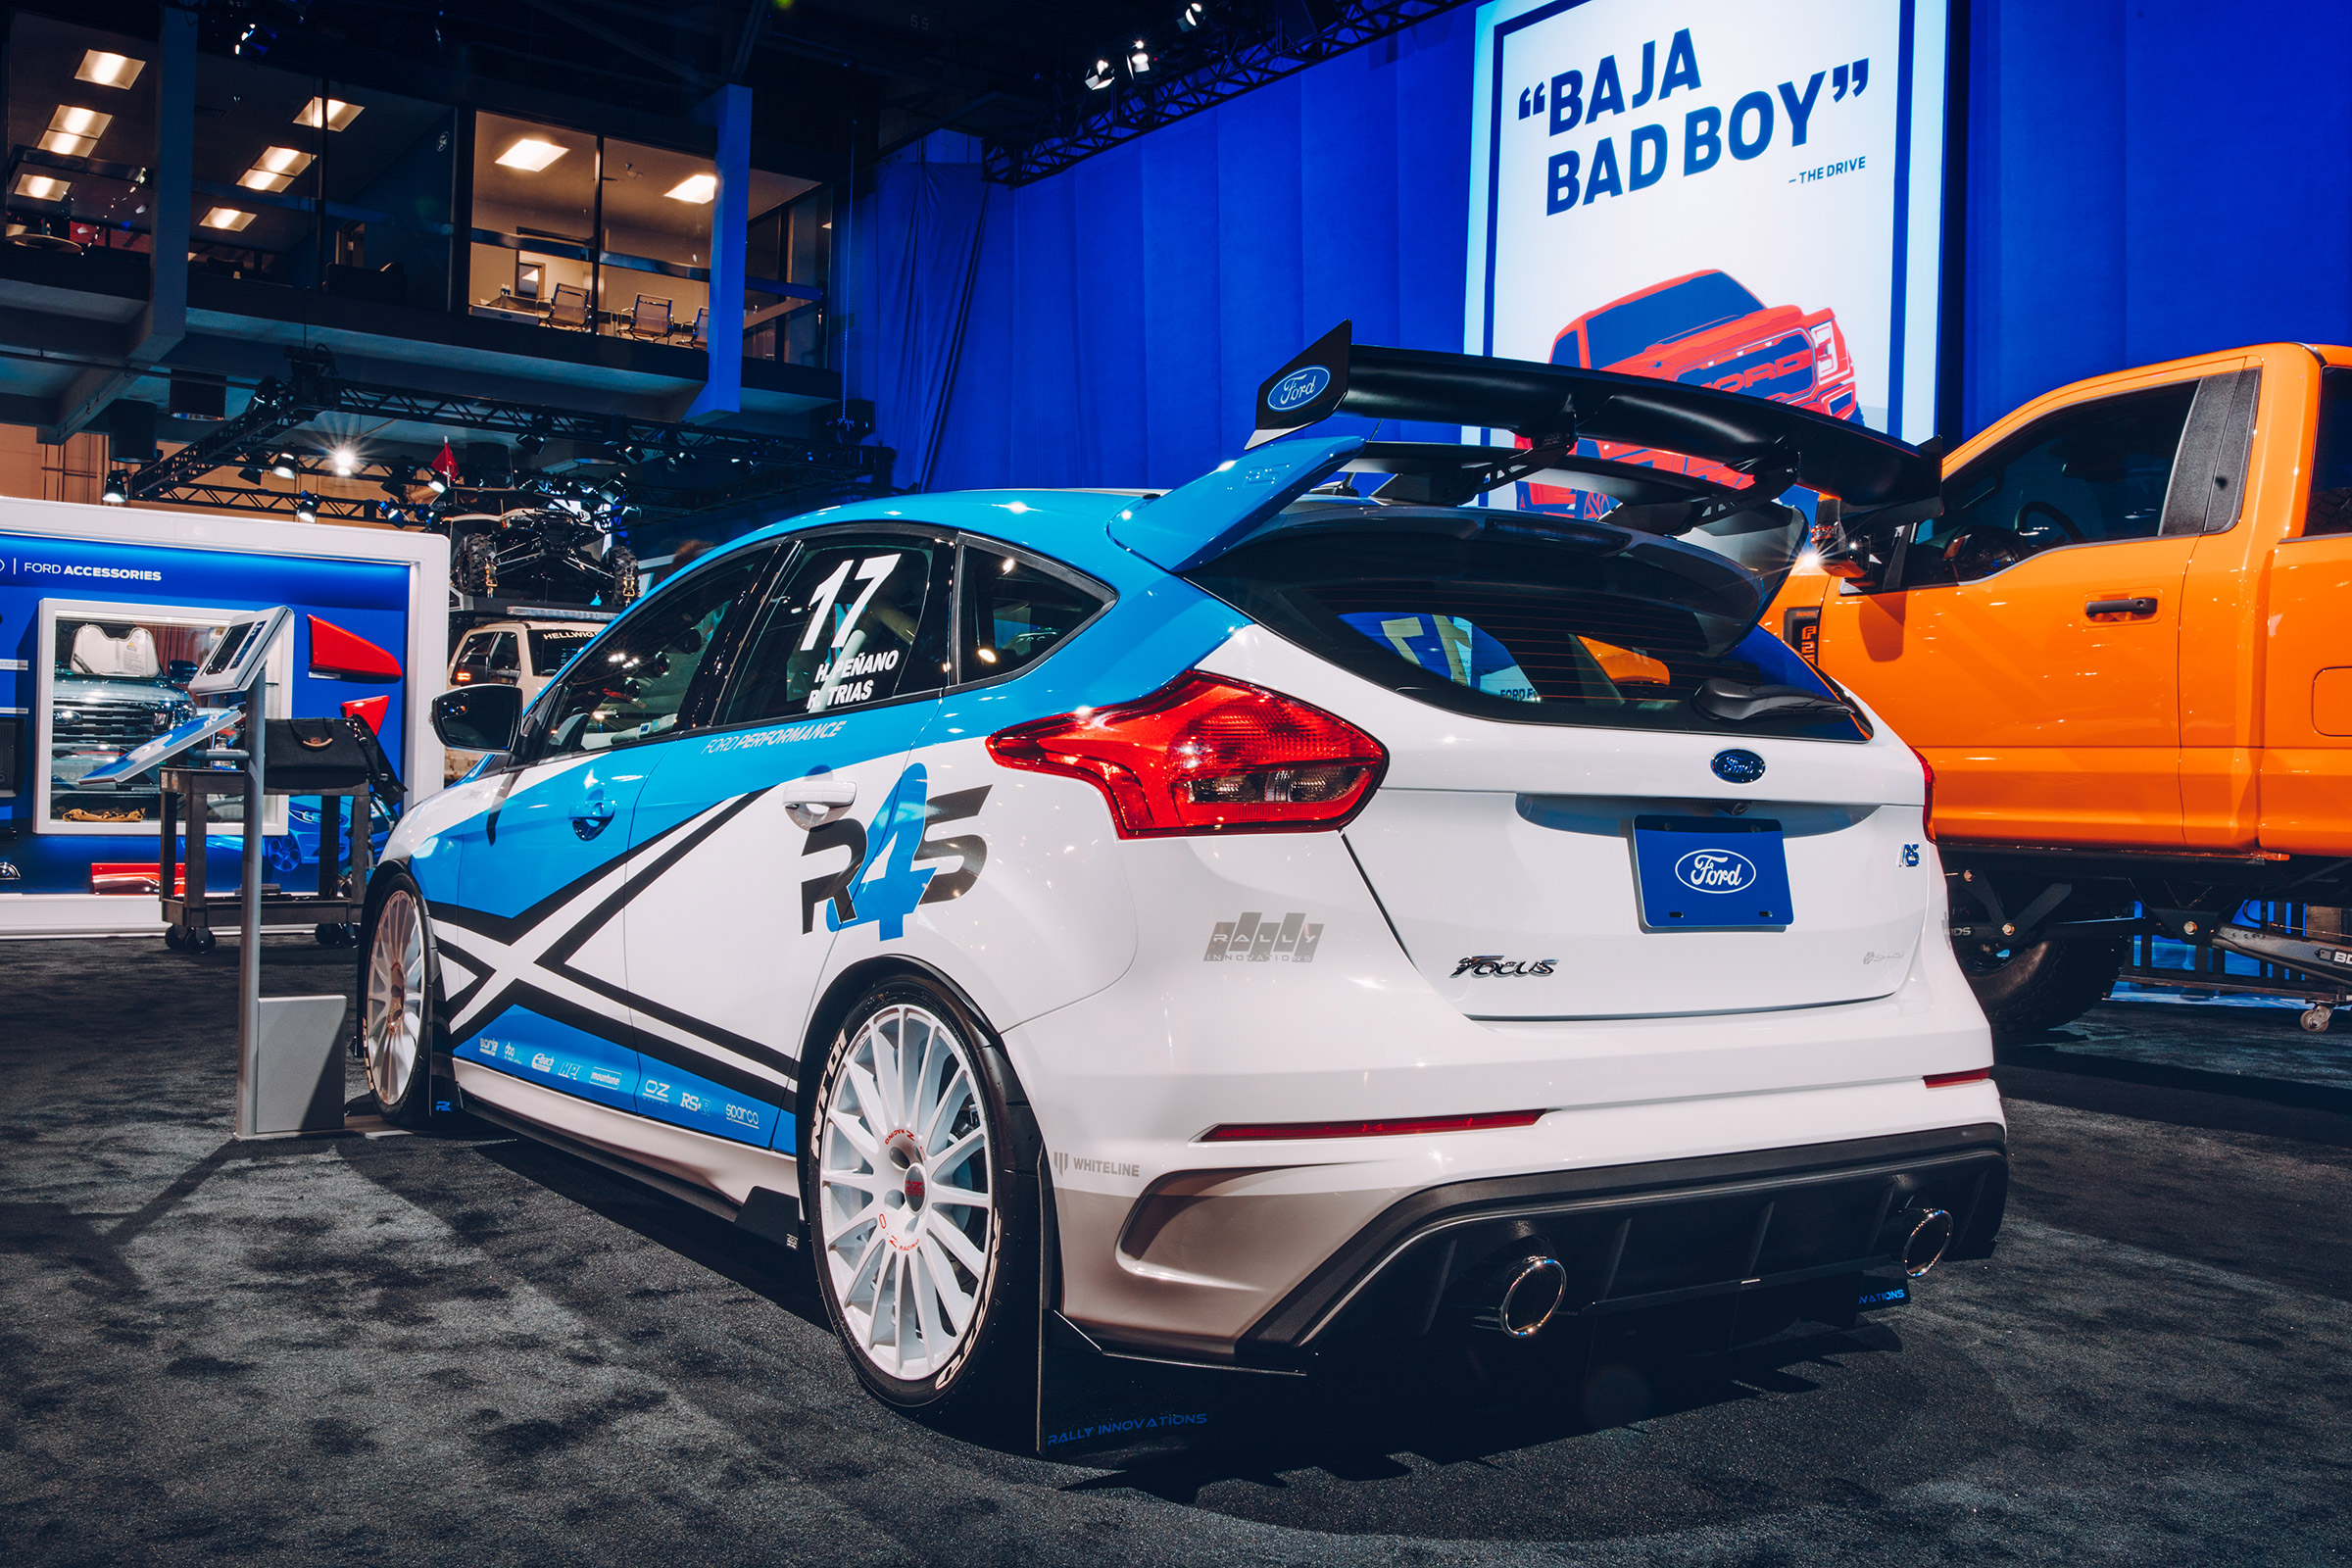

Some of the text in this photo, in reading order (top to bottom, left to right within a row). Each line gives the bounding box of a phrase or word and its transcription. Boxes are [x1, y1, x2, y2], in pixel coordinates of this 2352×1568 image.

[1546, 122, 1668, 217] BAD
[1799, 167, 1824, 184] THE
[1827, 156, 1866, 177] DRIVE
[1700, 349, 1813, 393] ORD
[1280, 373, 1317, 405] Ford
[24, 562, 162, 581] FORD ACCESSORIES
[799, 553, 902, 651] 17
[831, 650, 900, 679] PEÑANO
[827, 679, 874, 707] TRIAS
[701, 720, 847, 755] FORD PERFORMANCE
[1723, 755, 1754, 774] Ford
[1690, 855, 1742, 886] Ford
[1073, 1157, 1140, 1177] WHITELINE
[1047, 1413, 1207, 1446] RALLY INNOVATIONS
